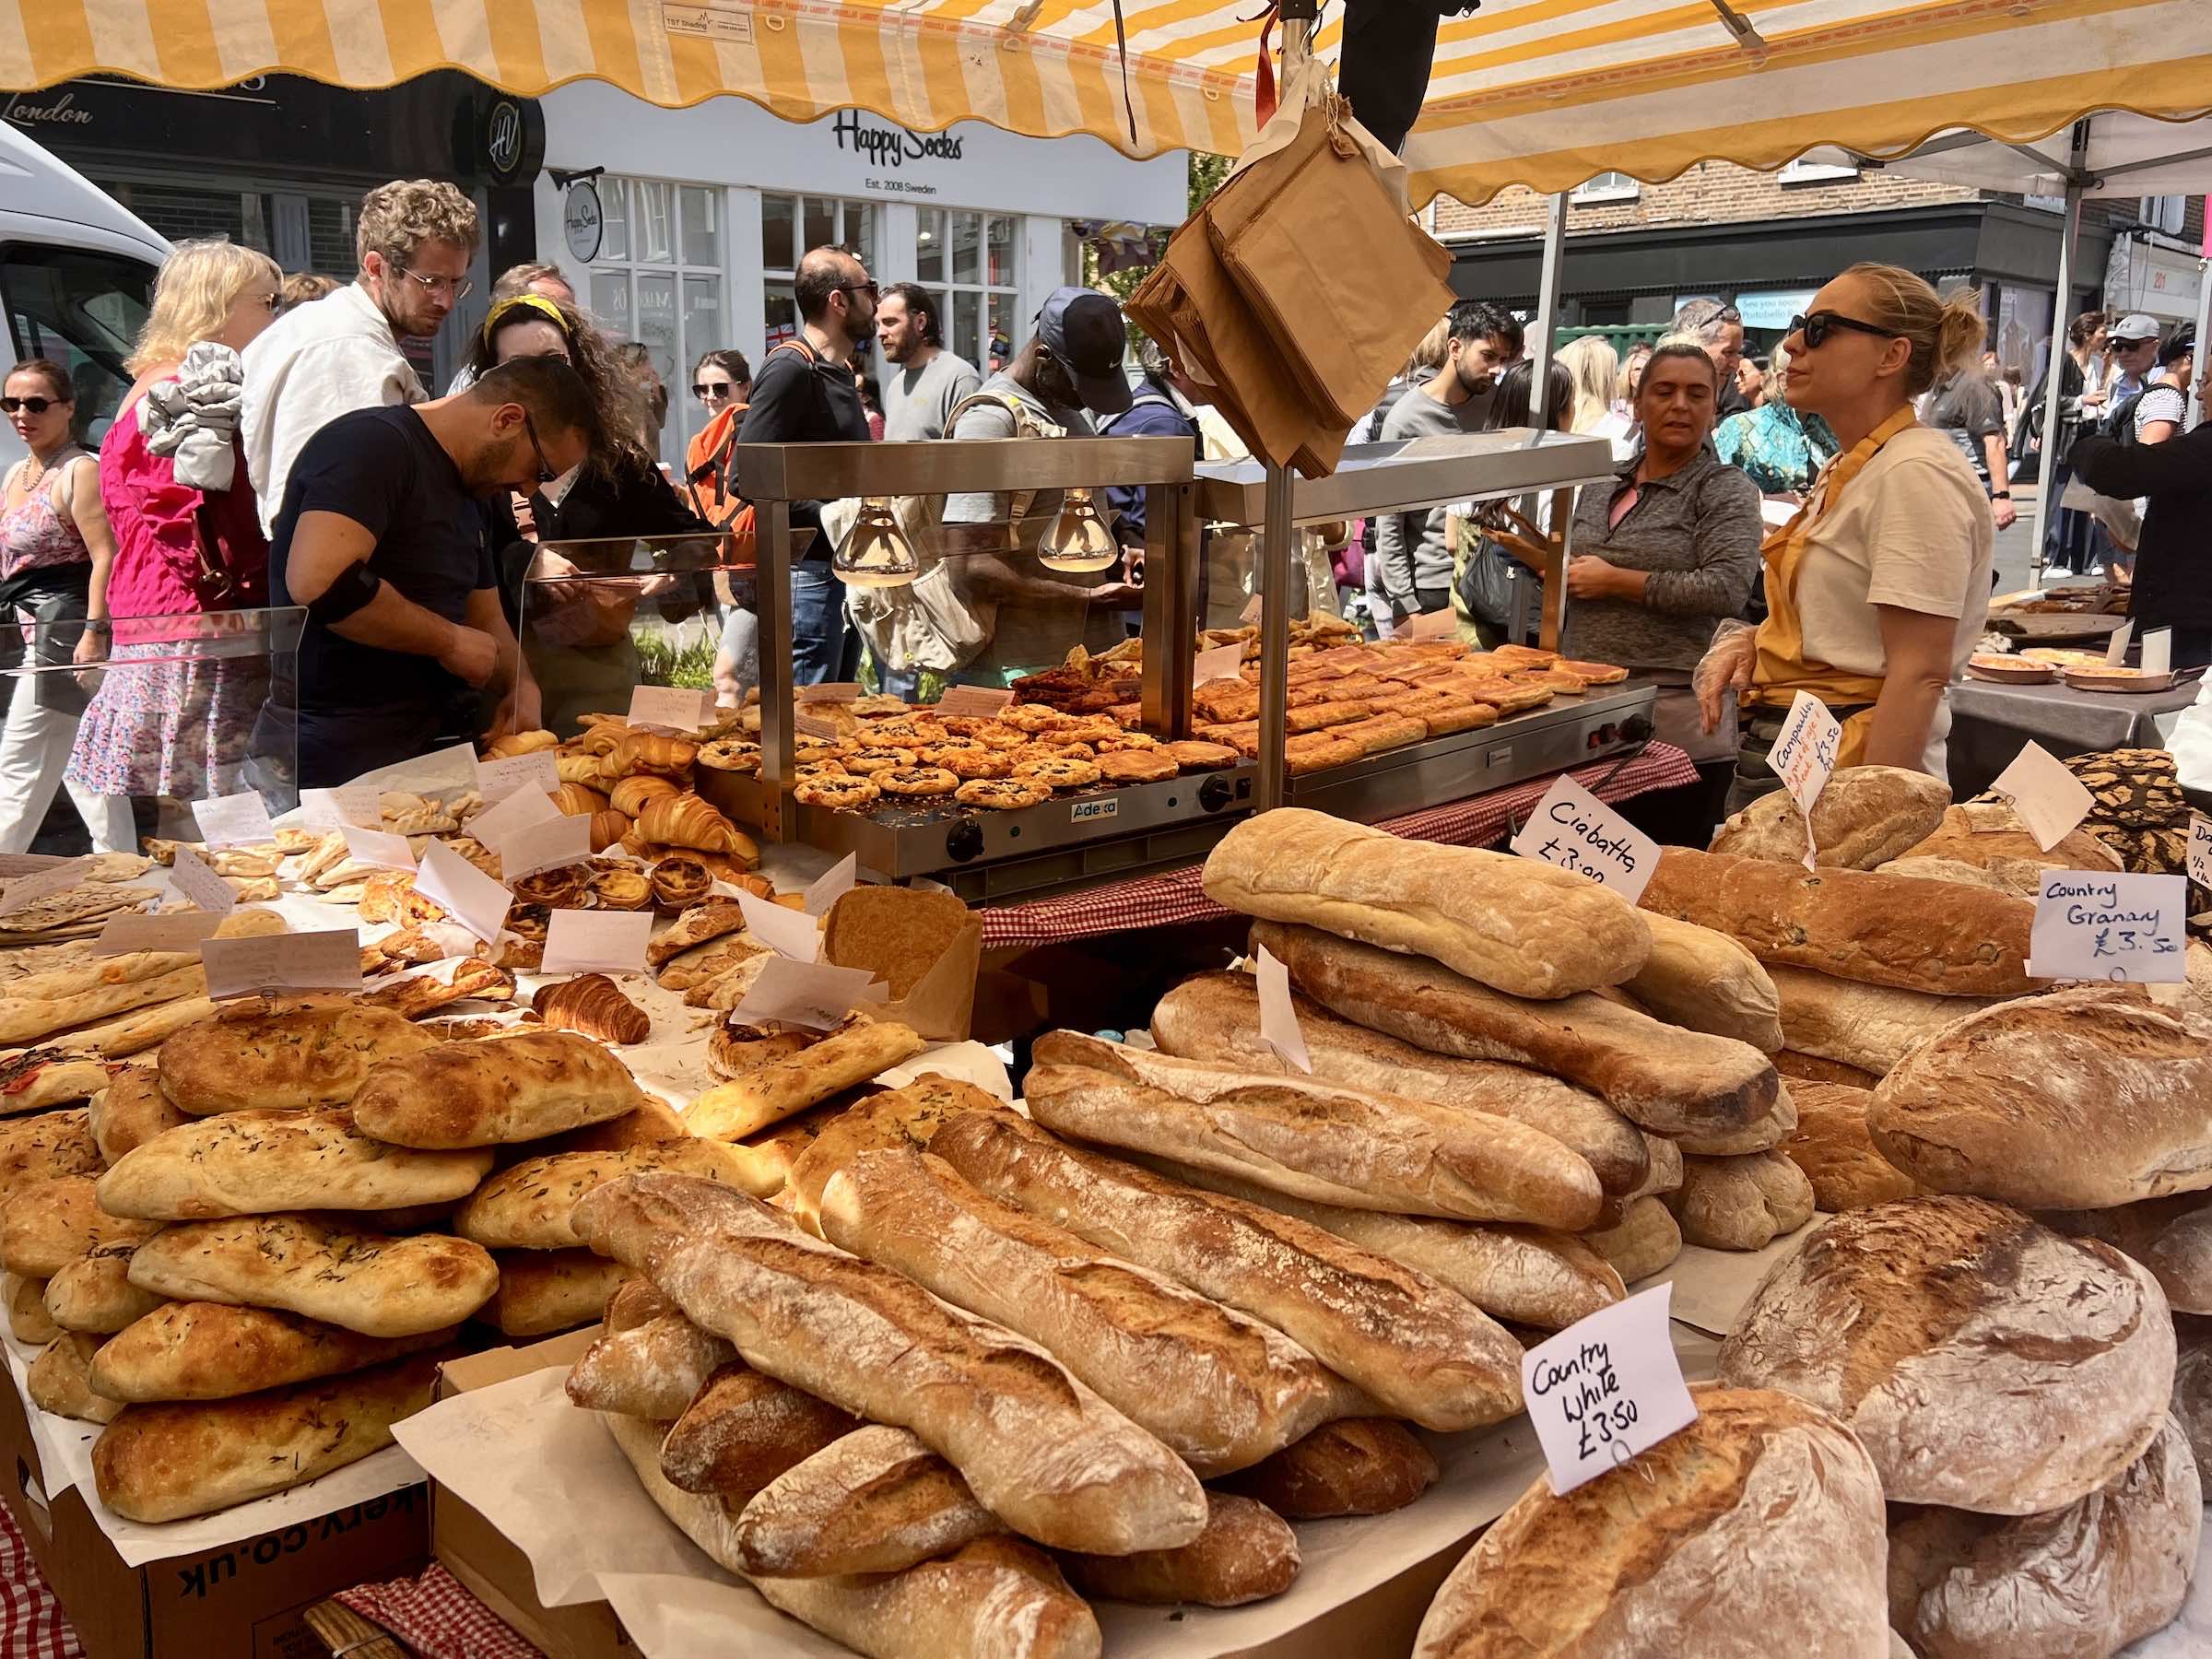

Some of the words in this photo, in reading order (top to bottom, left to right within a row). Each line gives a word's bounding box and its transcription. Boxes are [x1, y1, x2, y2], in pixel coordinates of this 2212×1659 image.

[2, 91, 94, 126] London
[832, 110, 902, 167] Happy
[903, 128, 962, 159] Socks
[865, 178, 882, 189] Est.
[884, 180, 903, 192] 2008
[904, 182, 936, 194] Sweden
[1743, 309, 1786, 319] Portobello
[1760, 301, 1777, 310] you
[1549, 802, 1636, 874] Ciabatta
[2046, 882, 2117, 909] Country
[1533, 1343, 1613, 1396] Country
[1562, 1368, 1619, 1423] White
[1579, 1399, 1638, 1460] £3.50
